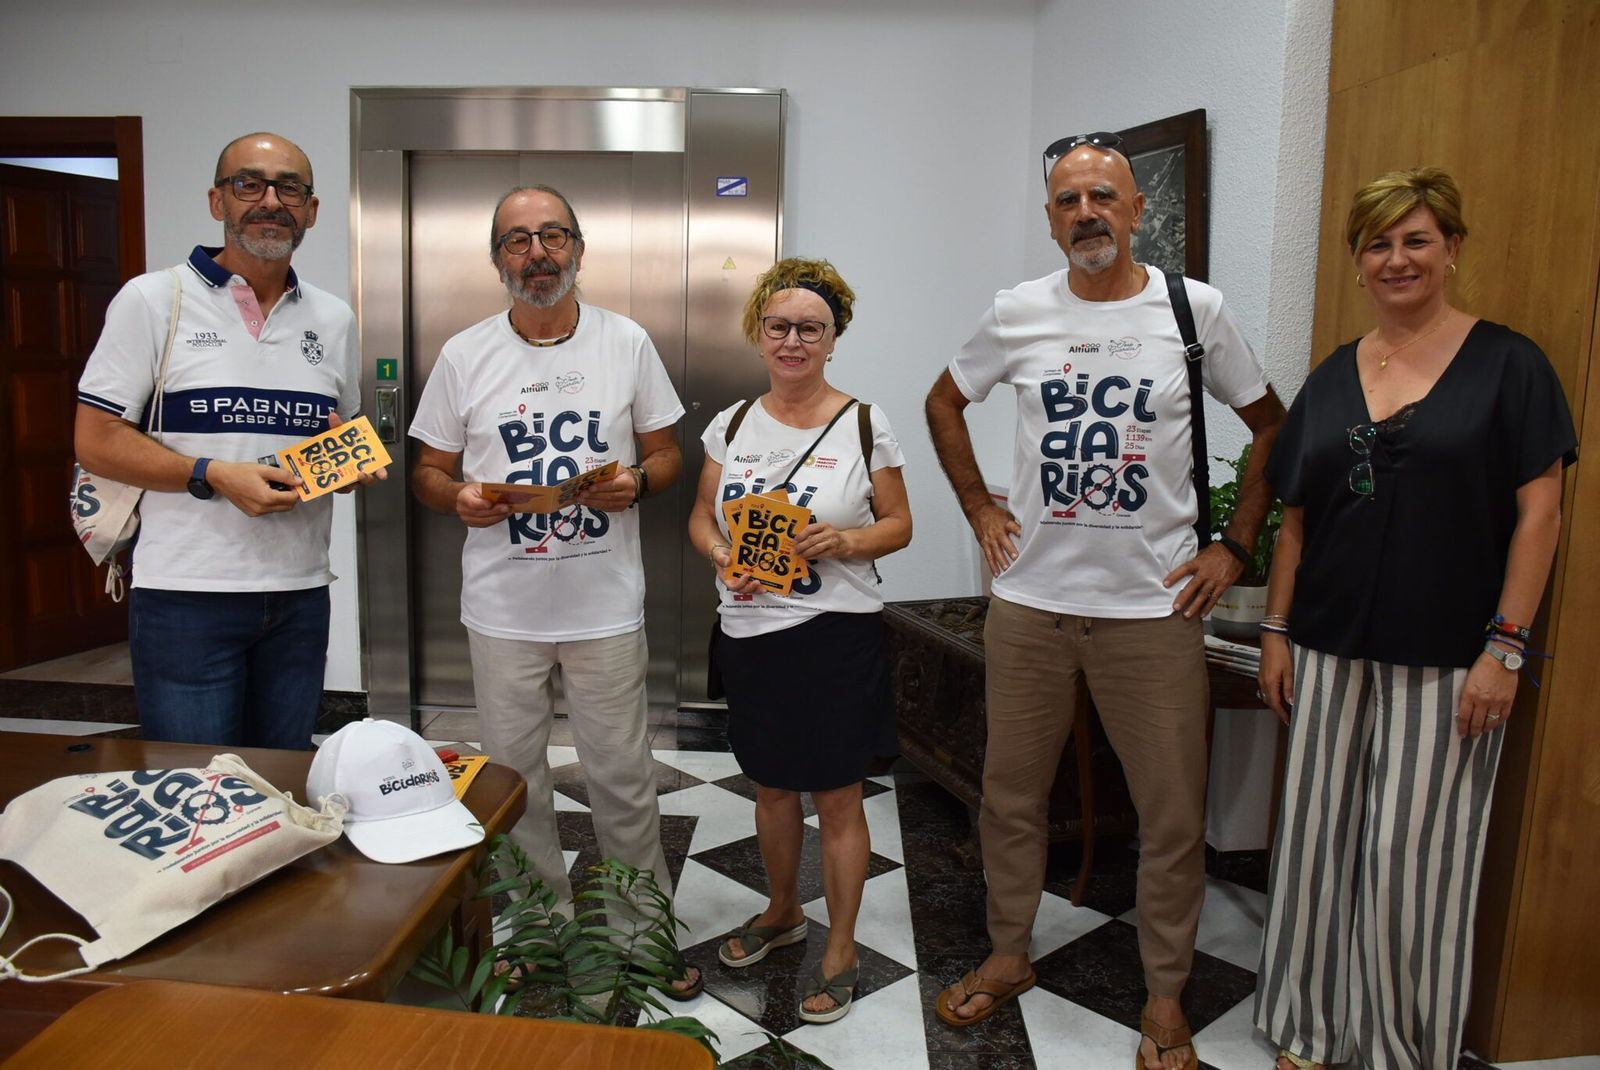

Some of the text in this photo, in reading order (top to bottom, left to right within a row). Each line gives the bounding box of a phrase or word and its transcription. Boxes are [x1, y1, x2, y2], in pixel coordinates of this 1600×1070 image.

[195, 332, 218, 340] 1933
[1069, 343, 1100, 353] Altium
[383, 363, 390, 377] 1
[520, 383, 549, 394] Altium
[222, 414, 320, 428] DESDE 1933
[1126, 425, 1136, 433] 23
[734, 455, 760, 464] Altium
